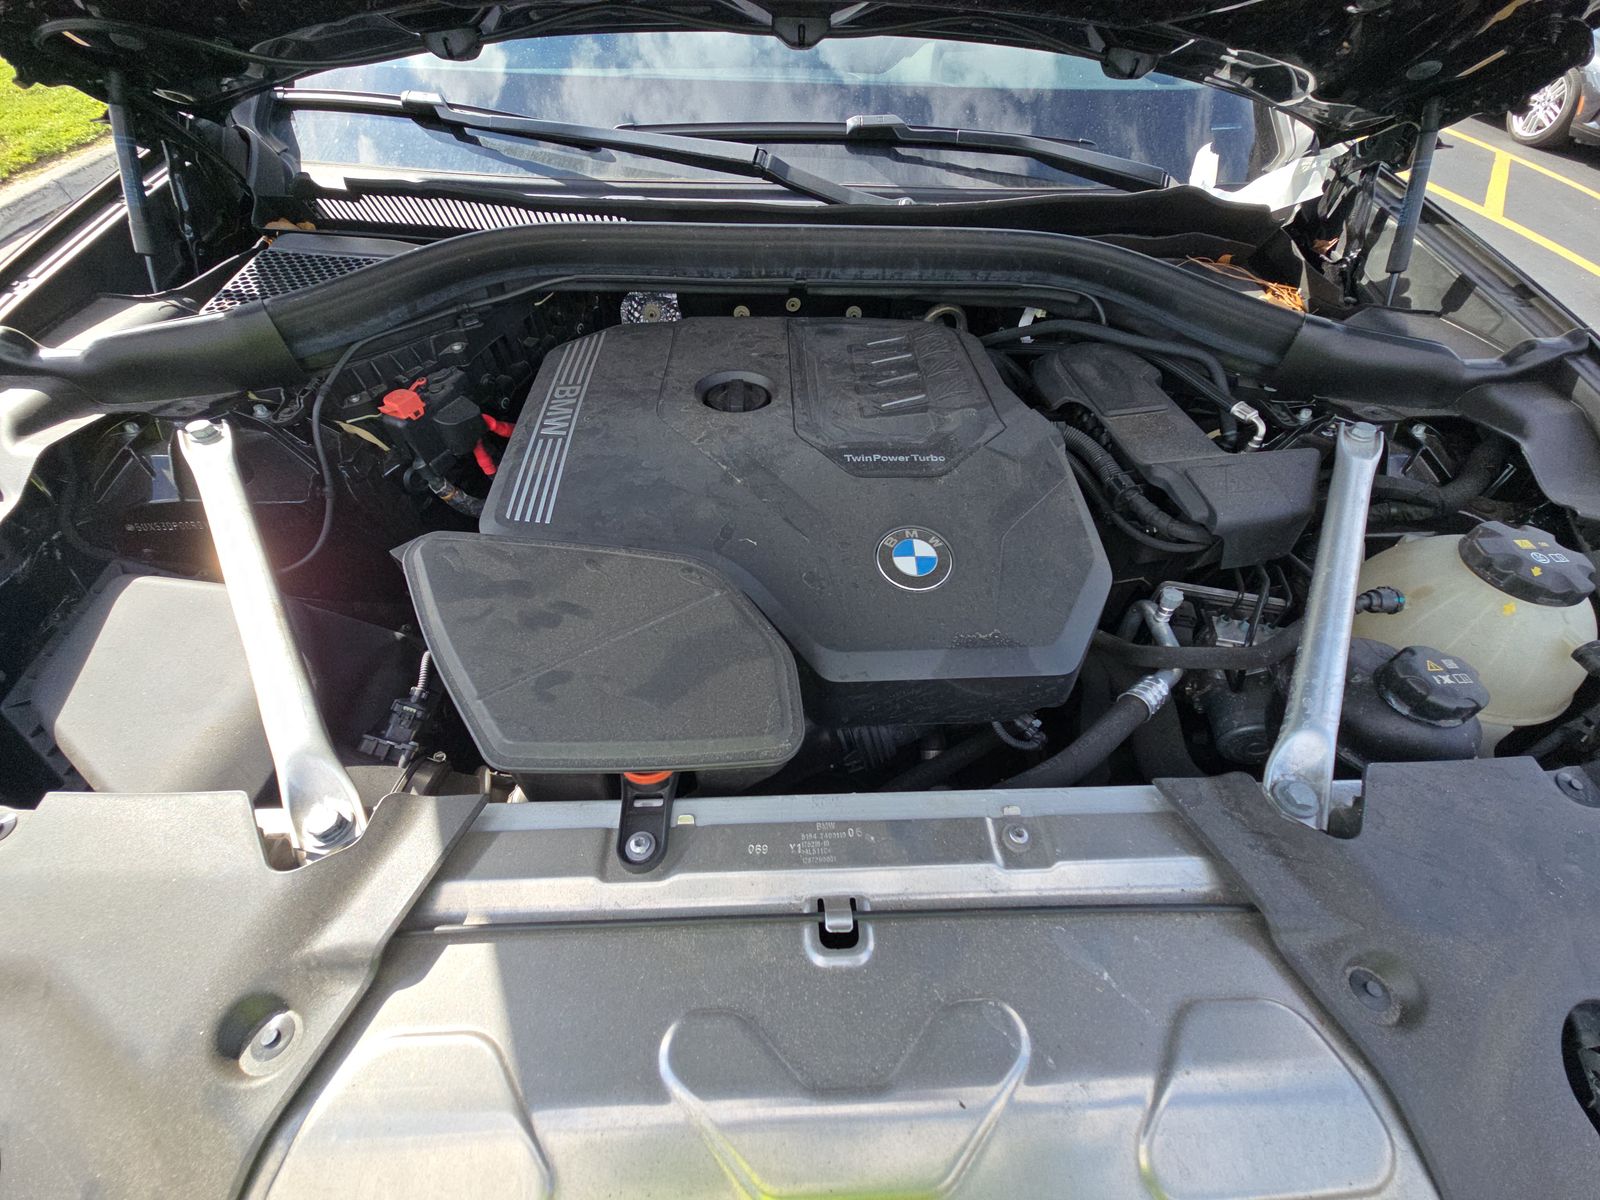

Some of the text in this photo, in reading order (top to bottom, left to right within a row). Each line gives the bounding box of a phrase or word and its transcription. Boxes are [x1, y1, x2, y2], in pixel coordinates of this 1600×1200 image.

[541, 385, 582, 436] BMW
[910, 453, 946, 463] Turbo
[884, 530, 944, 548] BMW
[816, 822, 836, 831] BMW
[747, 844, 769, 855] 069
